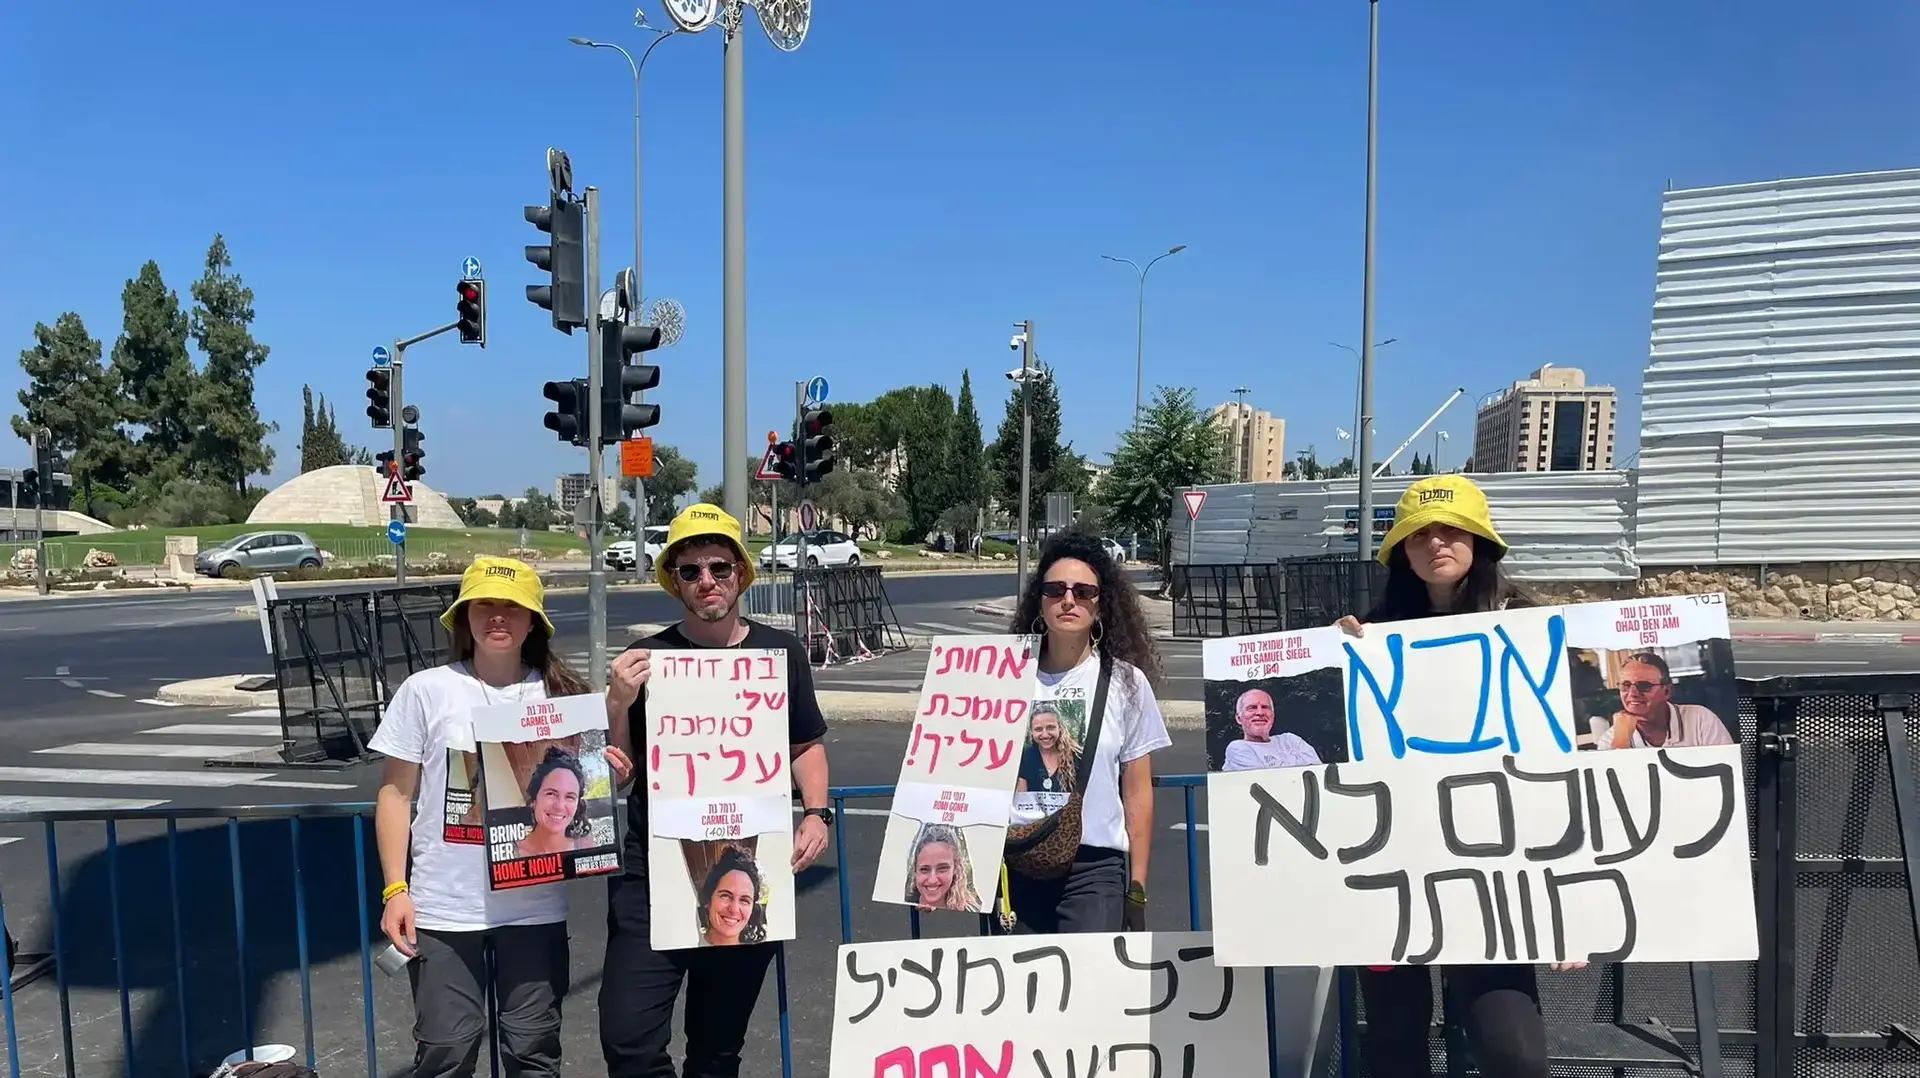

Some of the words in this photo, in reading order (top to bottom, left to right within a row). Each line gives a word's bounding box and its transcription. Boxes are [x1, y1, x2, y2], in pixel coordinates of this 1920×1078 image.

[1620, 606, 1637, 619] עמי
[1639, 605, 1648, 619] בן
[1650, 604, 1673, 618] אוהד
[1615, 619, 1640, 632] OHAD
[1642, 618, 1660, 631] BEN
[1662, 617, 1680, 630] AMI
[1639, 631, 1658, 645] (55)
[1238, 642, 1256, 654] סיגל
[1258, 639, 1284, 652] שמואל
[934, 645, 1031, 679] אחותי
[1230, 653, 1252, 667] KEITH
[1253, 651, 1284, 664] SAMUEL
[1286, 648, 1312, 661] SIEGEL
[663, 656, 724, 679] דודה
[728, 656, 780, 681] בת
[1246, 666, 1261, 678] 65
[1062, 687, 1086, 698] 275
[1342, 614, 1573, 761] אבא
[735, 688, 787, 712] שלי
[526, 705, 536, 716] גת
[537, 703, 555, 714] כרמל
[922, 693, 1027, 724] סומכת
[520, 716, 549, 727] CARMEL
[550, 713, 563, 724] GAT
[656, 714, 754, 738] סומכת
[536, 726, 551, 737] (39)
[906, 723, 1014, 775] עליך!
[651, 743, 782, 798] עליך!
[446, 801, 468, 815] BRING
[708, 804, 717, 814] גת
[719, 803, 736, 813] כרמל
[933, 800, 949, 811] ROMI
[949, 802, 969, 813] GONEN
[1438, 750, 1734, 865] לעולם
[446, 814, 460, 825] HER
[702, 815, 729, 825] CARMEL
[730, 814, 743, 824] GAT
[942, 811, 955, 823] (23)
[1250, 762, 1393, 866] לא
[446, 826, 466, 838] HOME
[489, 822, 526, 844] BRING
[706, 827, 725, 838] (40)
[491, 842, 515, 862] HER
[493, 861, 528, 882] HOME
[528, 853, 563, 878] NOW!
[1344, 867, 1636, 964] מוותר
[1114, 935, 1234, 1021] כל
[846, 946, 1071, 1025] המציל
